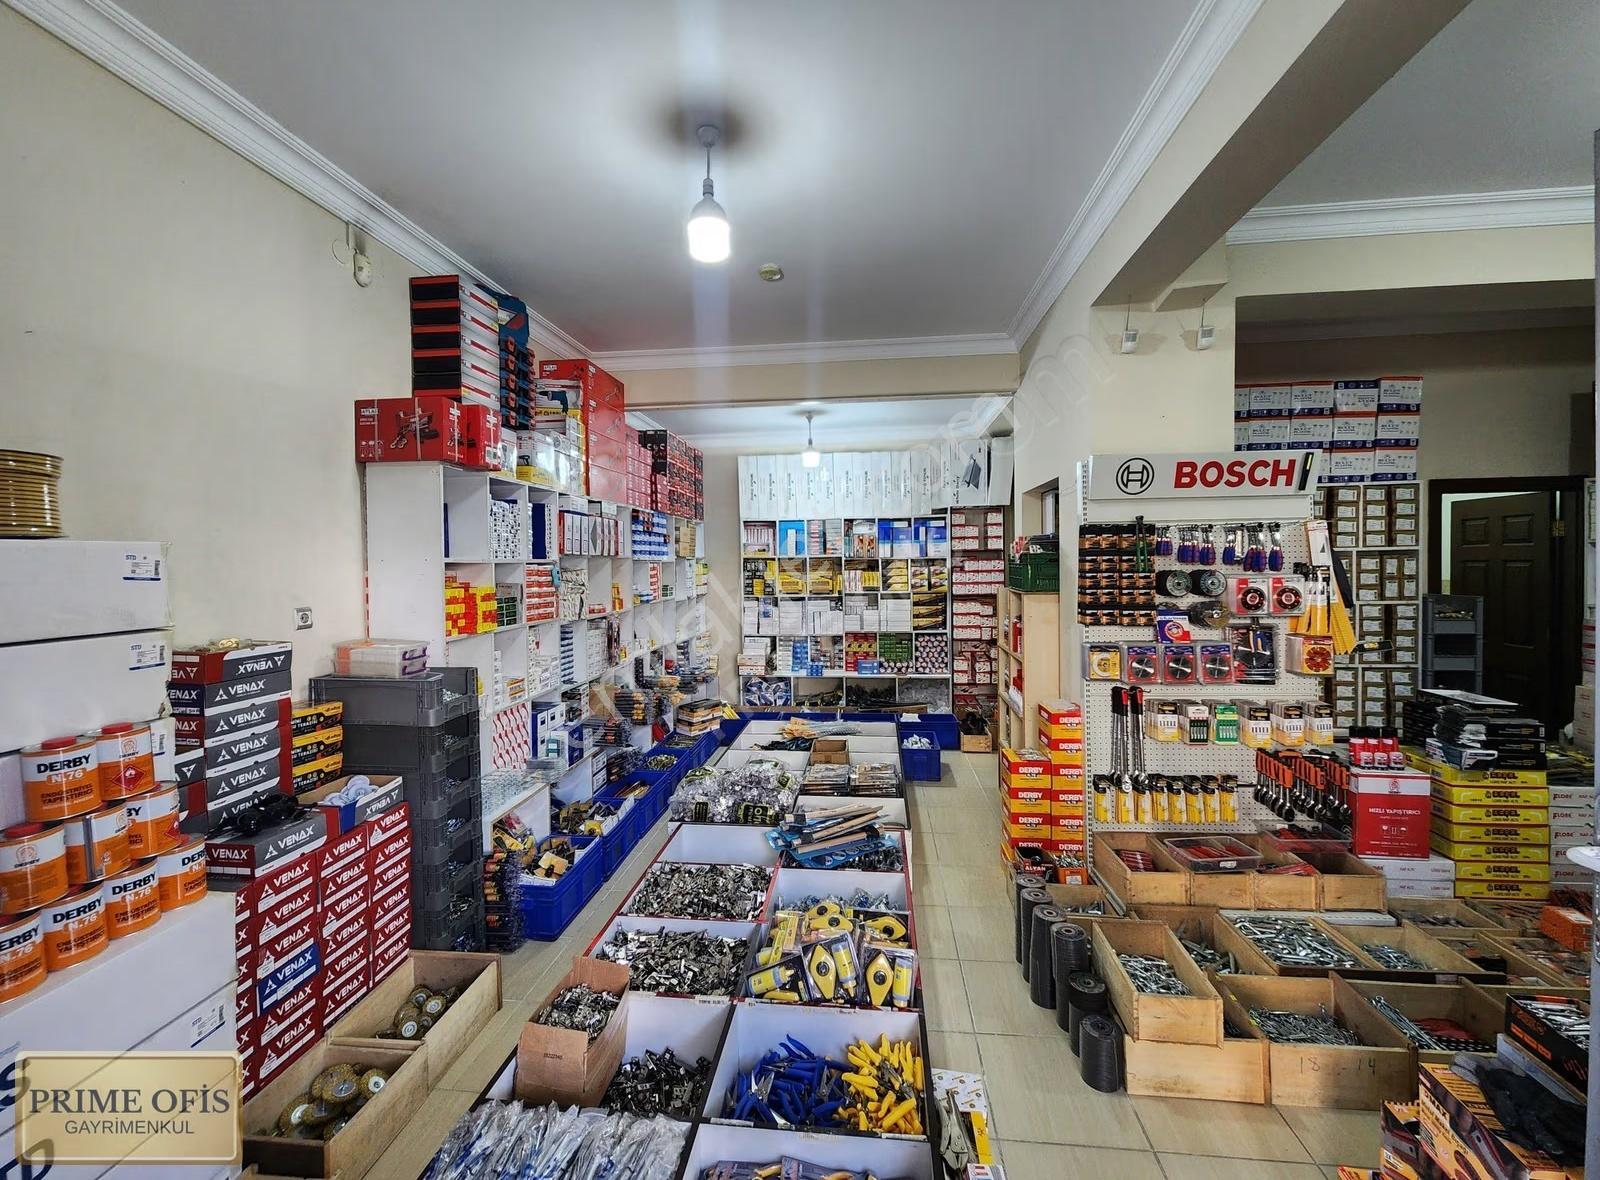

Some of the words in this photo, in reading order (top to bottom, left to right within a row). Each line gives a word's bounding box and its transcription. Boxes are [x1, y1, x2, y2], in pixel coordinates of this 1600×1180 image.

[1174, 459, 1297, 489] BOSCH
[238, 661, 273, 674] VENAX
[228, 680, 265, 694] VENAX
[176, 721, 198, 731] NAX
[229, 708, 267, 725] VENAX
[231, 736, 268, 753] VENAX
[37, 753, 91, 774] DERBY
[51, 769, 84, 784] N.76
[230, 766, 267, 785] VENAX
[364, 798, 391, 817] VENAX
[380, 807, 406, 827] VENAX
[278, 825, 314, 849] VENAX
[333, 833, 363, 857] VENAX
[384, 835, 409, 856] VENAX
[182, 850, 206, 866] DER
[211, 848, 250, 860] VENAX
[273, 860, 310, 888] VENAX
[335, 860, 365, 885] VENAX
[382, 860, 407, 882] VENAX
[112, 872, 156, 895] DERBY
[125, 887, 152, 901] N.76
[274, 891, 311, 919] VENAX
[335, 887, 364, 913] VENAX
[383, 886, 408, 908] VENAX
[53, 896, 104, 924] DERBY
[68, 914, 98, 930] N.76
[336, 915, 365, 942] VENAX
[384, 911, 408, 934] VENAX
[0, 924, 40, 951] ERBY
[275, 923, 311, 951] VENAX
[384, 935, 408, 960] VENAX
[277, 951, 313, 980] VENAX
[335, 944, 364, 971] VENAX
[335, 972, 365, 1000] VENAX
[276, 983, 313, 1016] VENAX
[276, 1015, 312, 1049] VENAX
